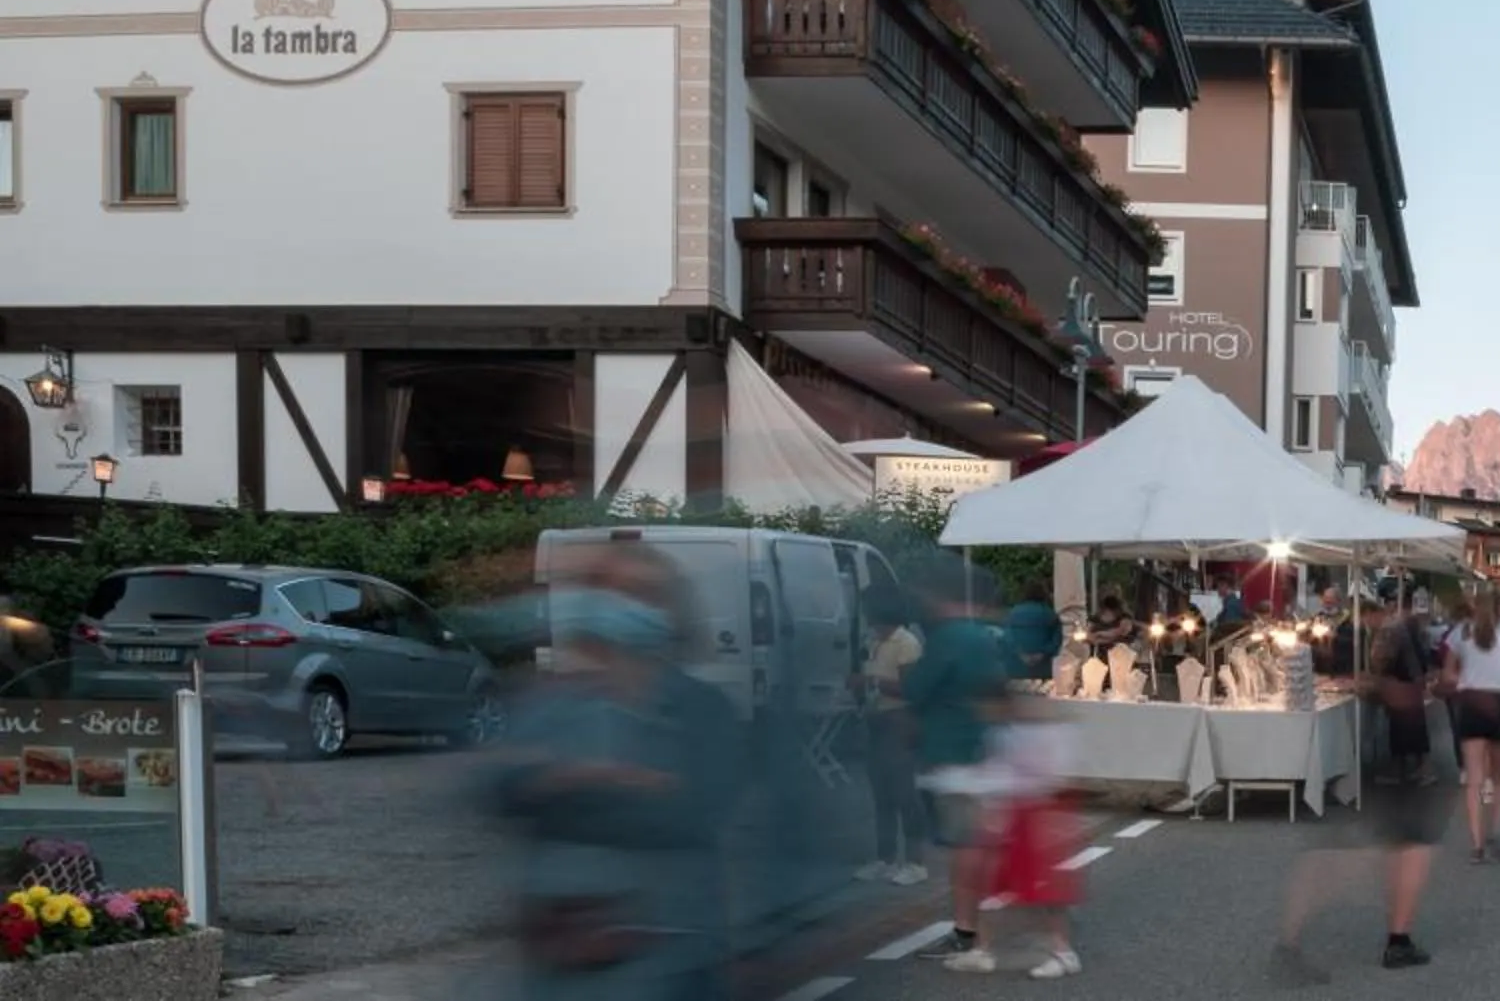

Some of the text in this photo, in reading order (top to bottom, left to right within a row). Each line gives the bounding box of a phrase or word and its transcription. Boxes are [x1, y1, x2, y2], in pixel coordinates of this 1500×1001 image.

[231, 23, 357, 55] la tambra
[1168, 311, 1230, 326] HOTEL
[896, 462, 990, 473] STEAKHOUSE
[81, 707, 164, 736] Brote
